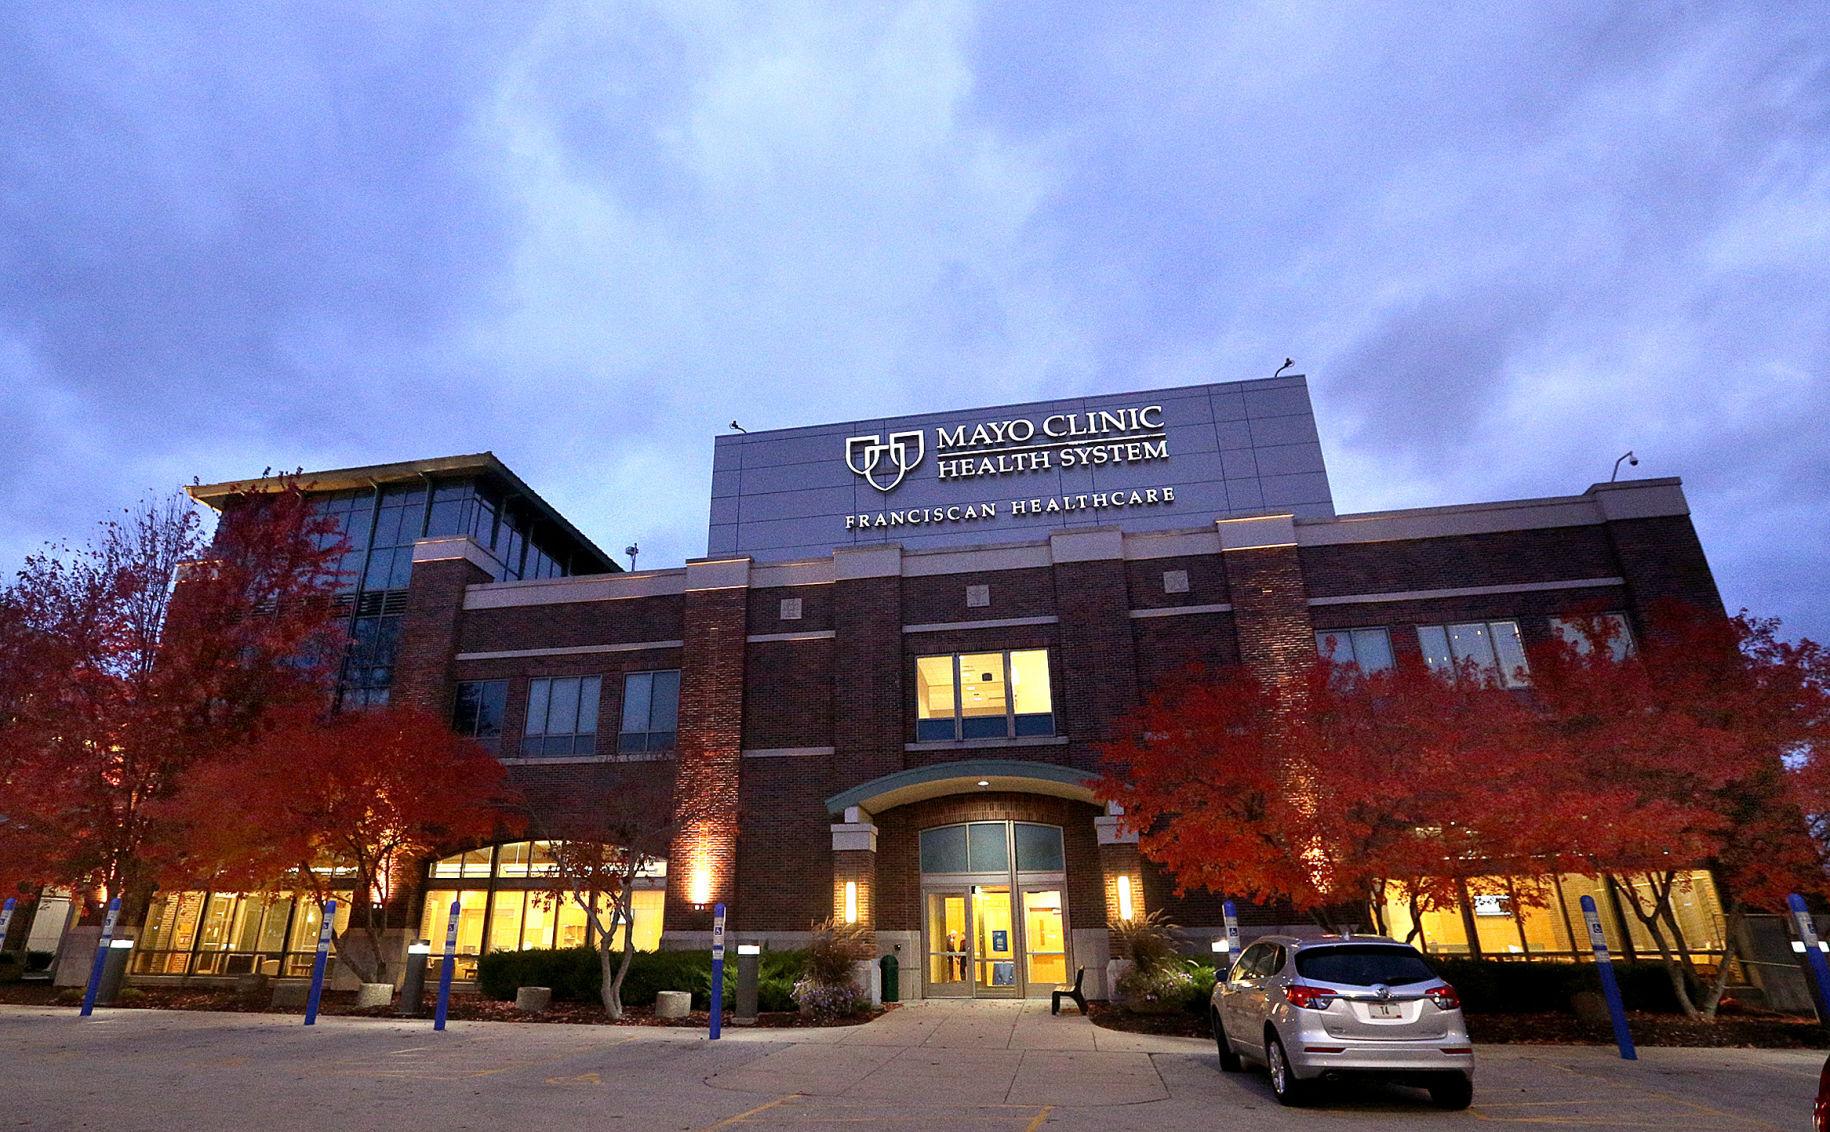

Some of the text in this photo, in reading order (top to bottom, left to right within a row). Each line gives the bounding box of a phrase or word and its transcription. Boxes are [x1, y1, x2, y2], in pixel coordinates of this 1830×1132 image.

[936, 405, 1165, 449] MAYO CLINIC
[937, 440, 1170, 478] HEALTH SYSTEM
[845, 487, 1175, 529] FRANCISCAN HEALTHCARE
